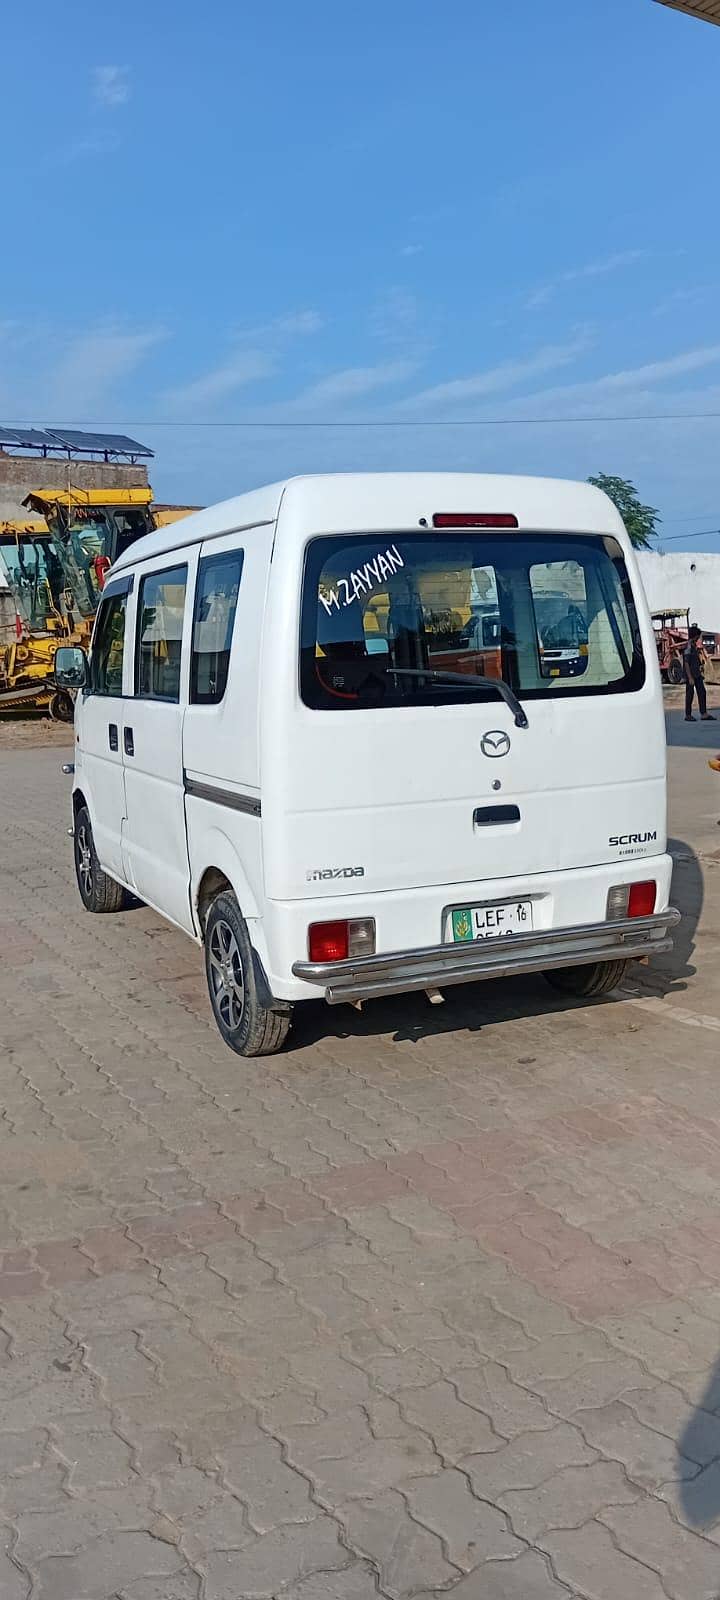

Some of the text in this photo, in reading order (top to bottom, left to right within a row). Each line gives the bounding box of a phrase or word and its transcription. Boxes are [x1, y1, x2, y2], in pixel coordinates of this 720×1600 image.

[319, 544, 404, 616] M.ZAYYAN
[608, 831, 657, 847] SCRUM
[475, 909, 505, 928] LEF
